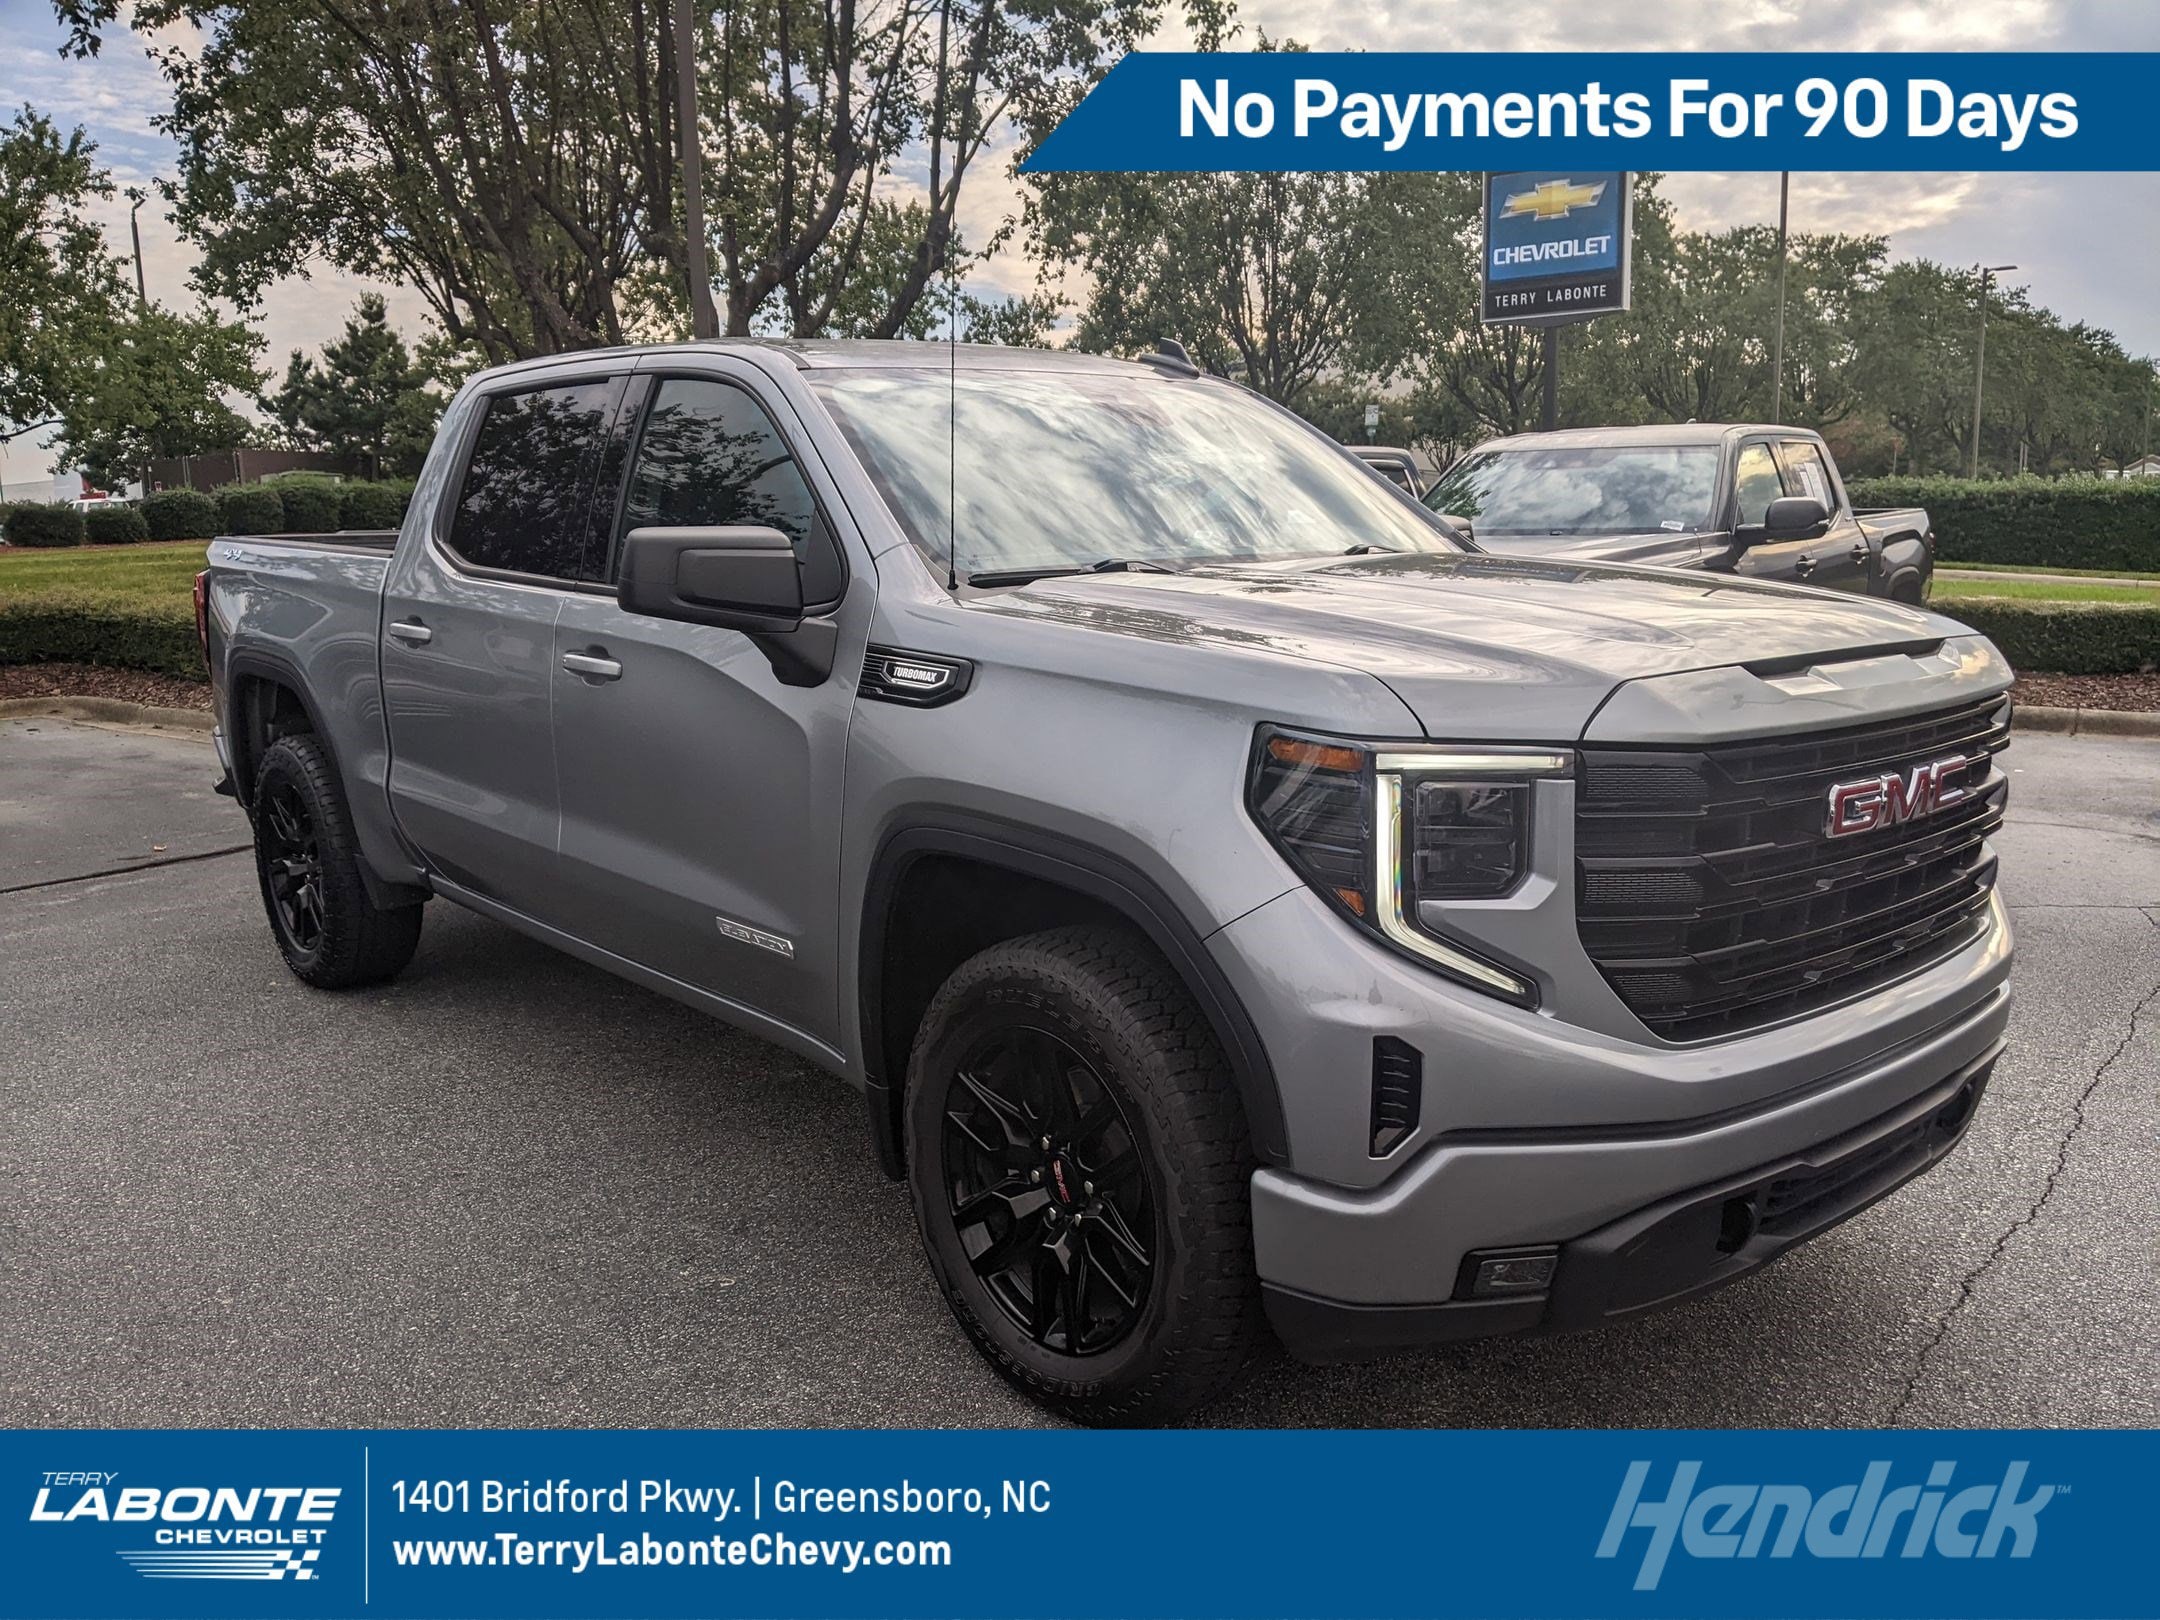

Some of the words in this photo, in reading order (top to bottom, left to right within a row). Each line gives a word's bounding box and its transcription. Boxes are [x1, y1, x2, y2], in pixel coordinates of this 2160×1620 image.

[1493, 235, 1611, 265] CHEVROLET
[1495, 292, 1536, 307] TERRY
[1547, 284, 1607, 302] LABONTE
[893, 665, 938, 683] TURBOMAX
[1825, 754, 1967, 839] GMC
